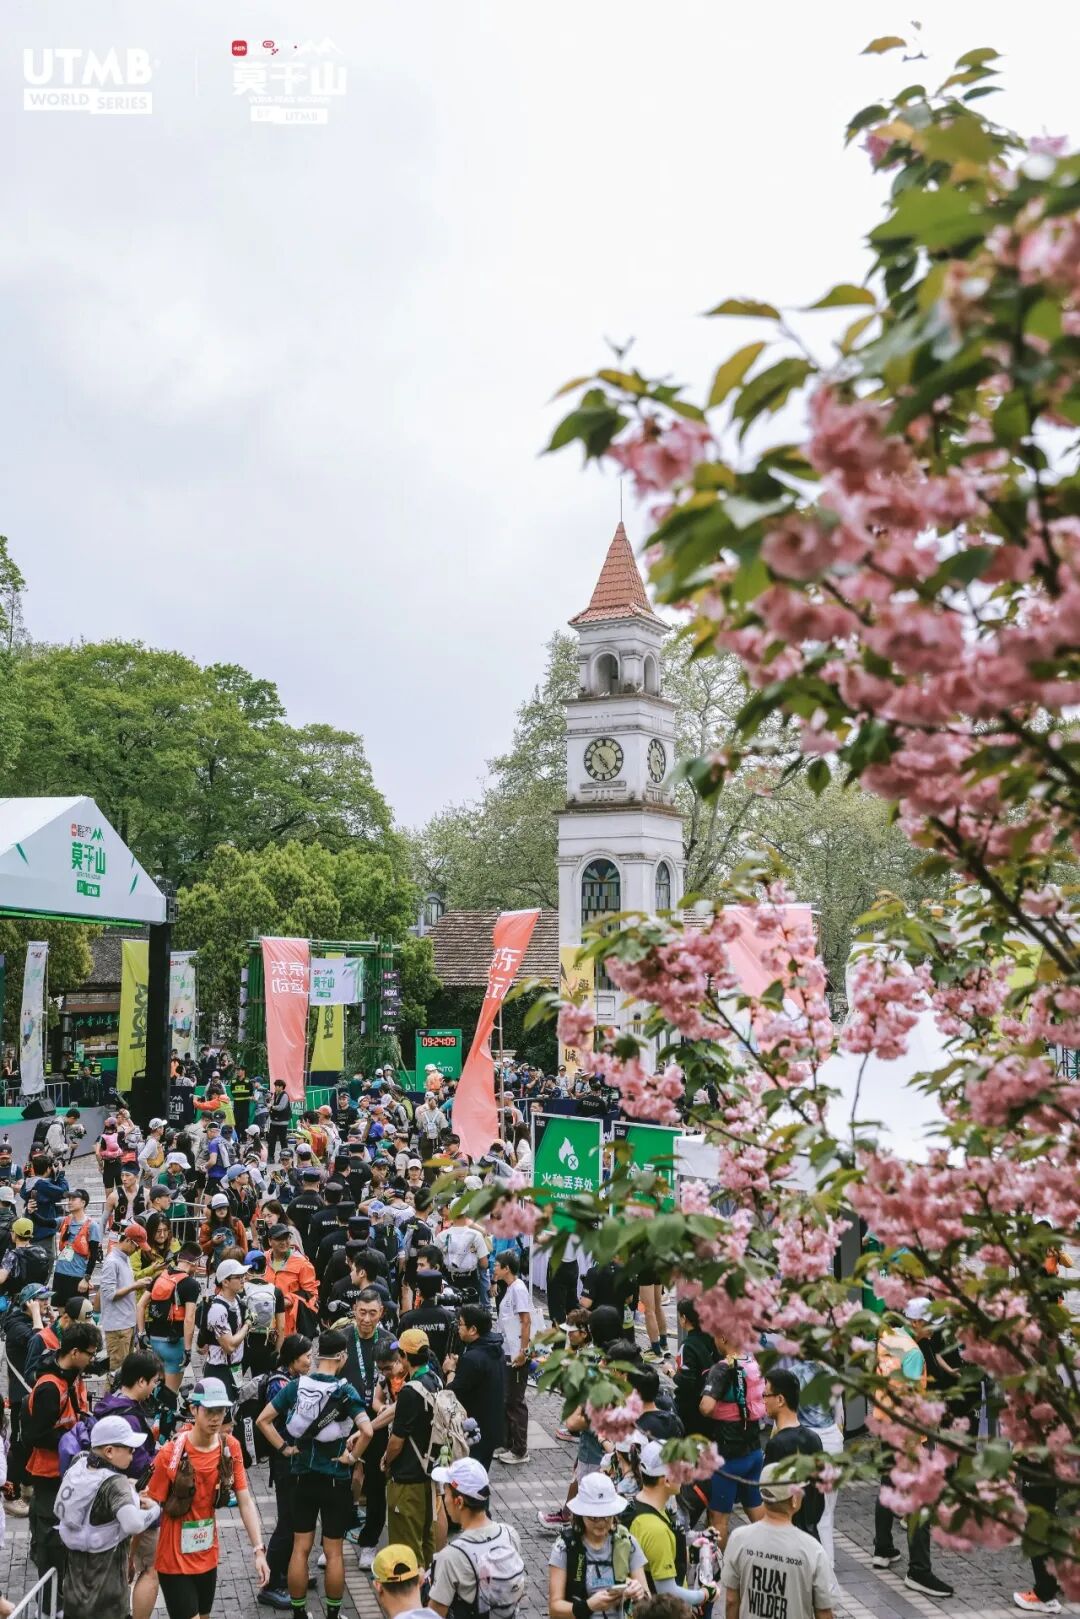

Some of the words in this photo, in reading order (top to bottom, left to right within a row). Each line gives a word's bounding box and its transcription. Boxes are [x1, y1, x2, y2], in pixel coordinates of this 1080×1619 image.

[72, 841, 106, 874] 莫干山
[422, 1036, 456, 1047] 09:24:09
[746, 1549, 764, 1559] 10-12
[765, 1554, 783, 1562] APRIL
[752, 1564, 787, 1597] RUN
[748, 1588, 788, 1619] WILDER
